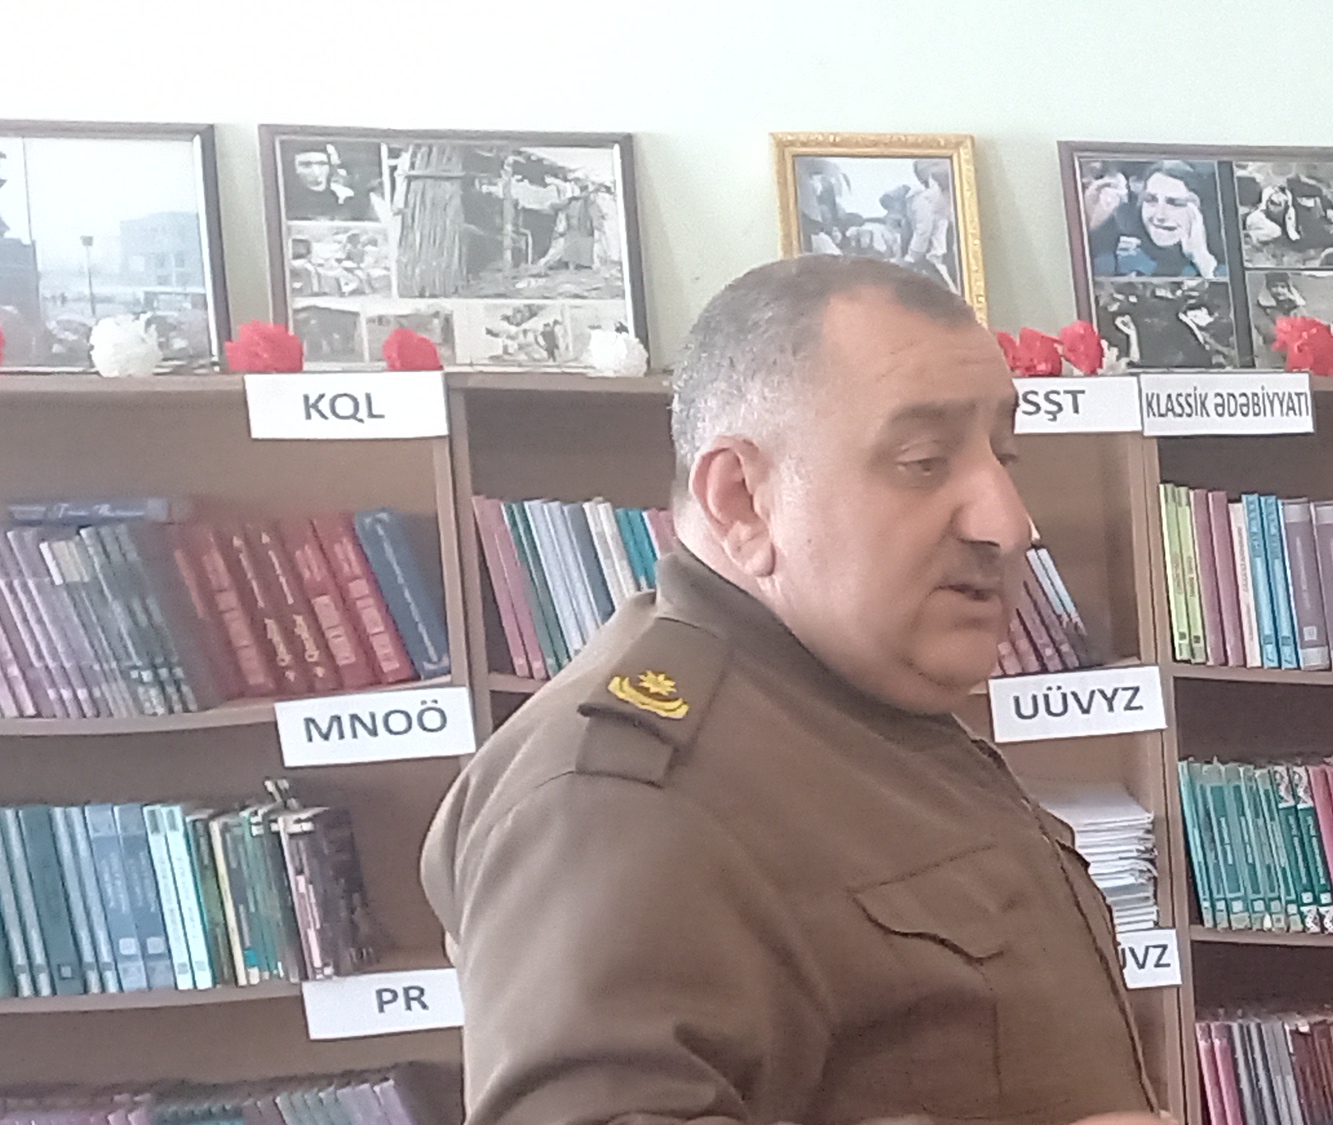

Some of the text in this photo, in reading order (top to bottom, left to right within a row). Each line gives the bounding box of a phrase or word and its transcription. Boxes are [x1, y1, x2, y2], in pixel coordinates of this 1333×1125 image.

[303, 393, 385, 422] KQL
[1021, 389, 1086, 421] SŞT
[1145, 384, 1310, 418] KLASSİK ƏDƏBİYYATI
[1012, 685, 1144, 720] UÜVYZ
[303, 698, 448, 744] MNOÖ
[375, 986, 429, 1014] PR
